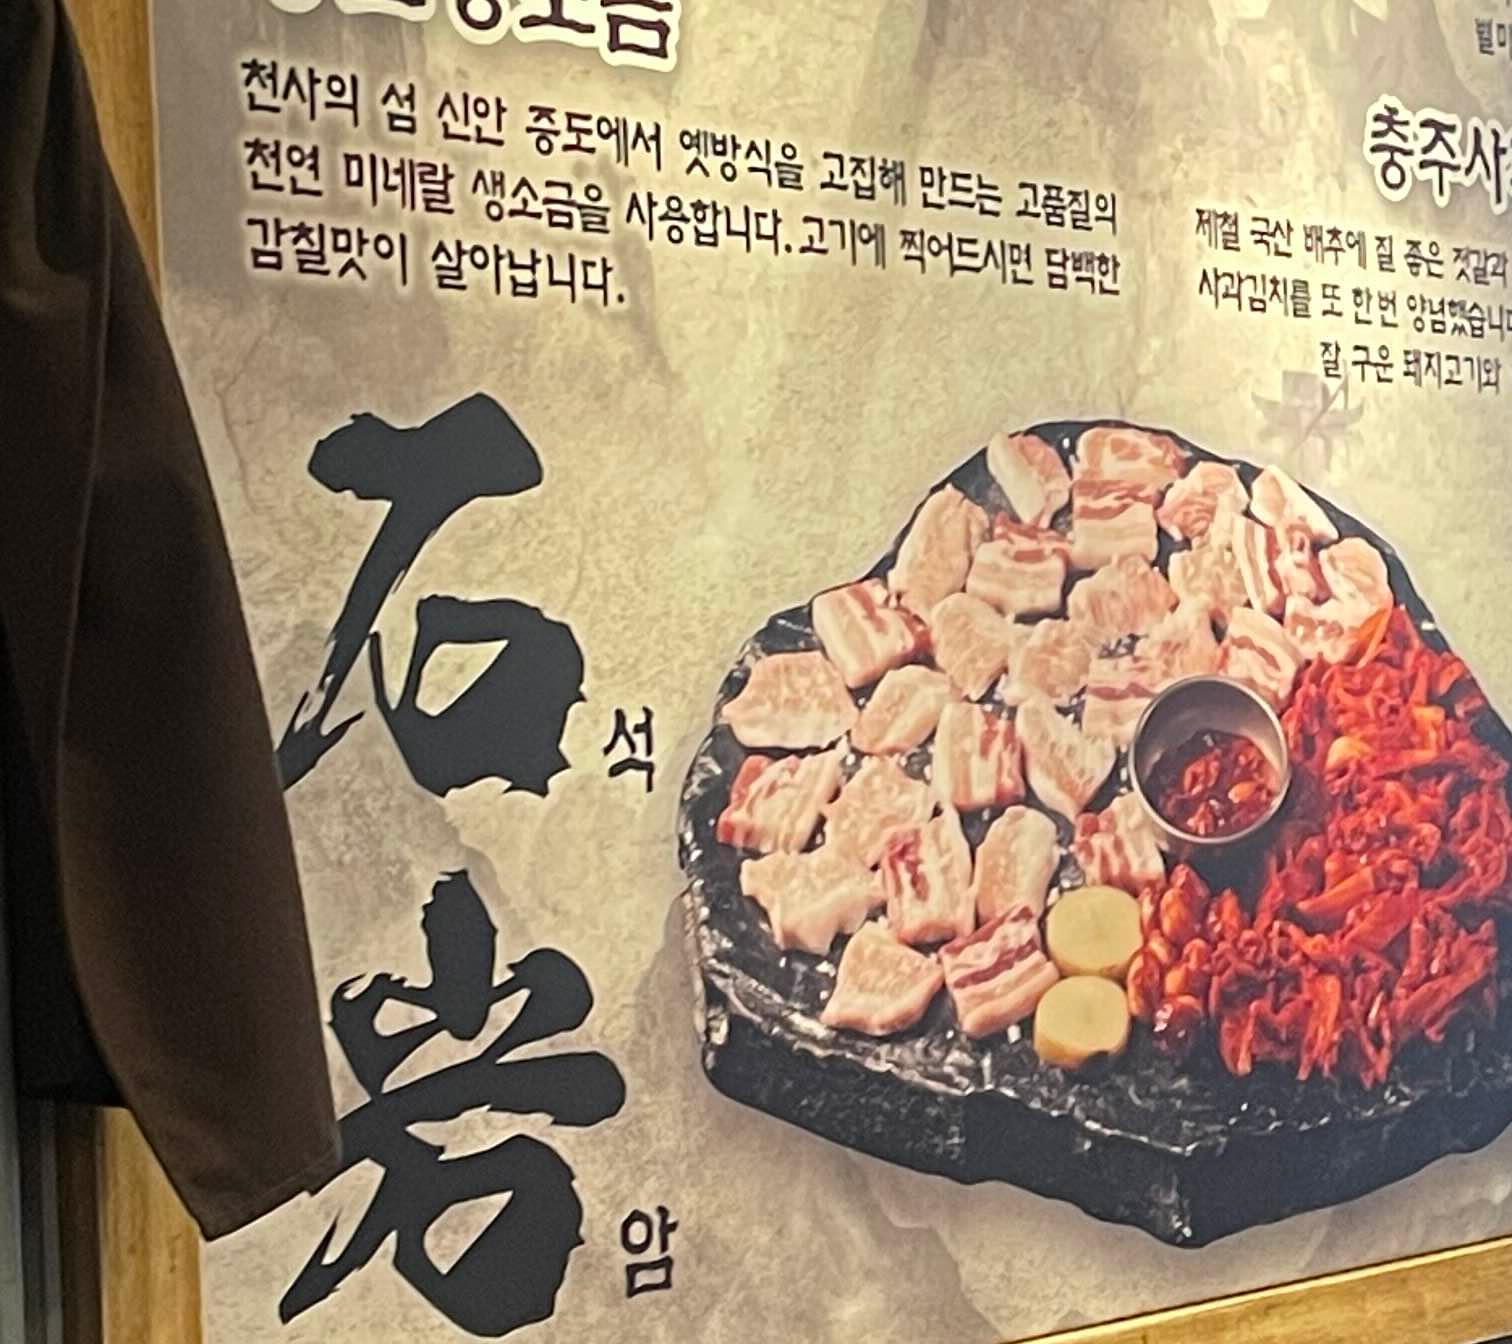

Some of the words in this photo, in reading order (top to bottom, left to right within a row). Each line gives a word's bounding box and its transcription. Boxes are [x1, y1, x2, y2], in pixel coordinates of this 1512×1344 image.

[241, 58, 359, 127] 천사의
[381, 82, 417, 134] 섬
[437, 92, 507, 147] 신안
[526, 105, 662, 172] 증도에서
[679, 128, 804, 191] 옛방식을
[821, 151, 907, 207] 고집해
[920, 166, 1003, 217] 만드는
[1016, 180, 1117, 235] 고품질의
[244, 138, 323, 197] 천연
[344, 152, 455, 215] 미네랄
[472, 169, 611, 234] 생소금을
[899, 229, 1034, 285] 찍어드시면
[1044, 246, 1121, 296] 담백한
[1195, 208, 1240, 251] 제철
[1250, 216, 1294, 258] 국산
[1303, 223, 1367, 270] 배추에
[1375, 234, 1396, 273] 질
[1403, 239, 1444, 279] 좋은
[246, 217, 408, 287] 감칠맛이
[432, 239, 625, 306] 살아납니다.
[1199, 267, 1311, 318] 사과김치를
[1321, 283, 1343, 316] 또
[1320, 340, 1342, 378] 잘
[1352, 344, 1394, 383] 구운
[603, 706, 653, 792] 석
[620, 1206, 680, 1298] 암
